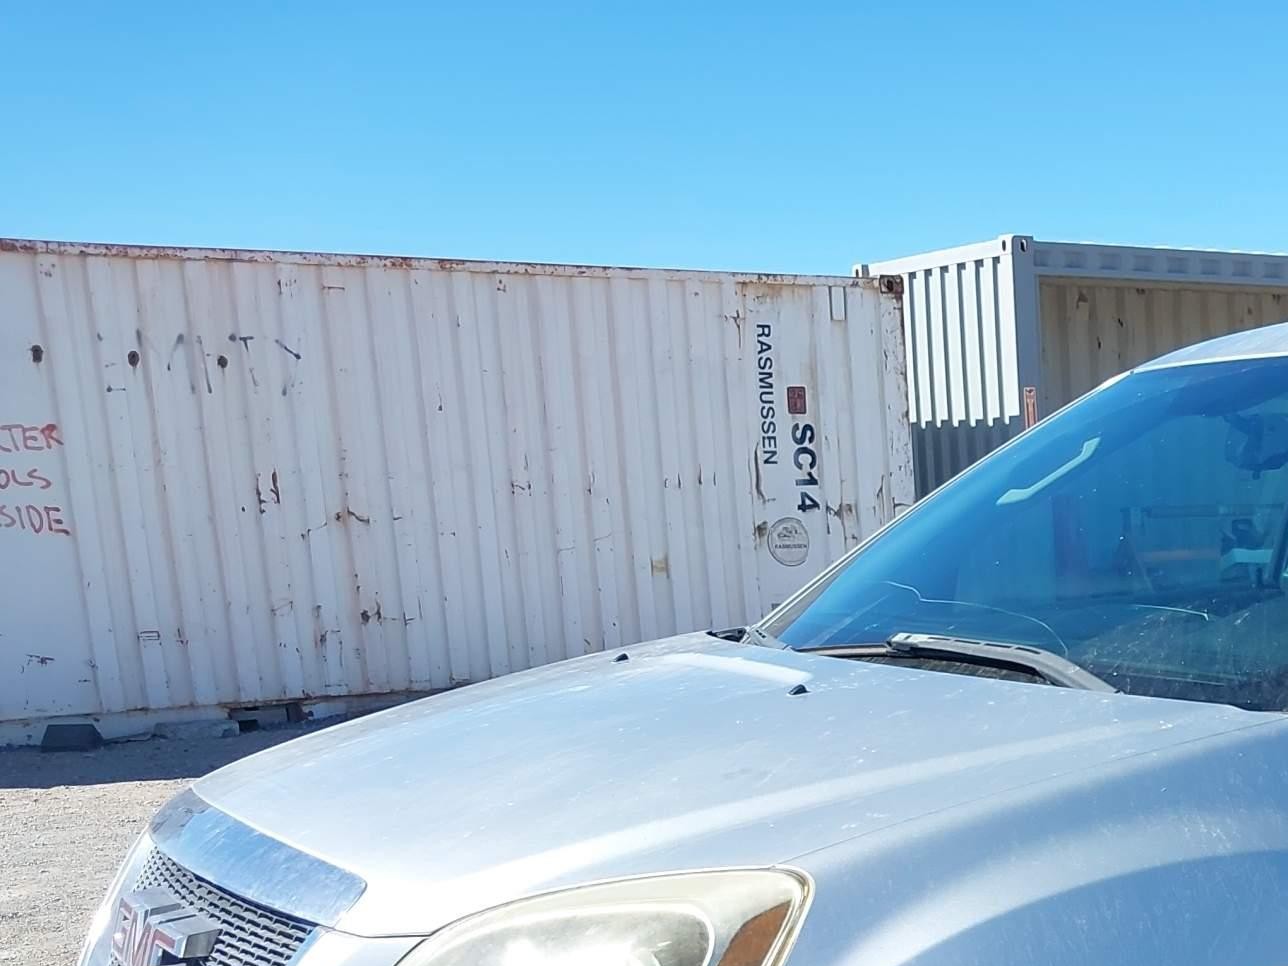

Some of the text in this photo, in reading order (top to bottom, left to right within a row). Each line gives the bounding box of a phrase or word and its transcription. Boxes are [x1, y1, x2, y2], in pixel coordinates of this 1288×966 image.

[0, 423, 64, 453] TER
[756, 324, 778, 465] RASMUSSEN
[791, 422, 821, 513] SC14
